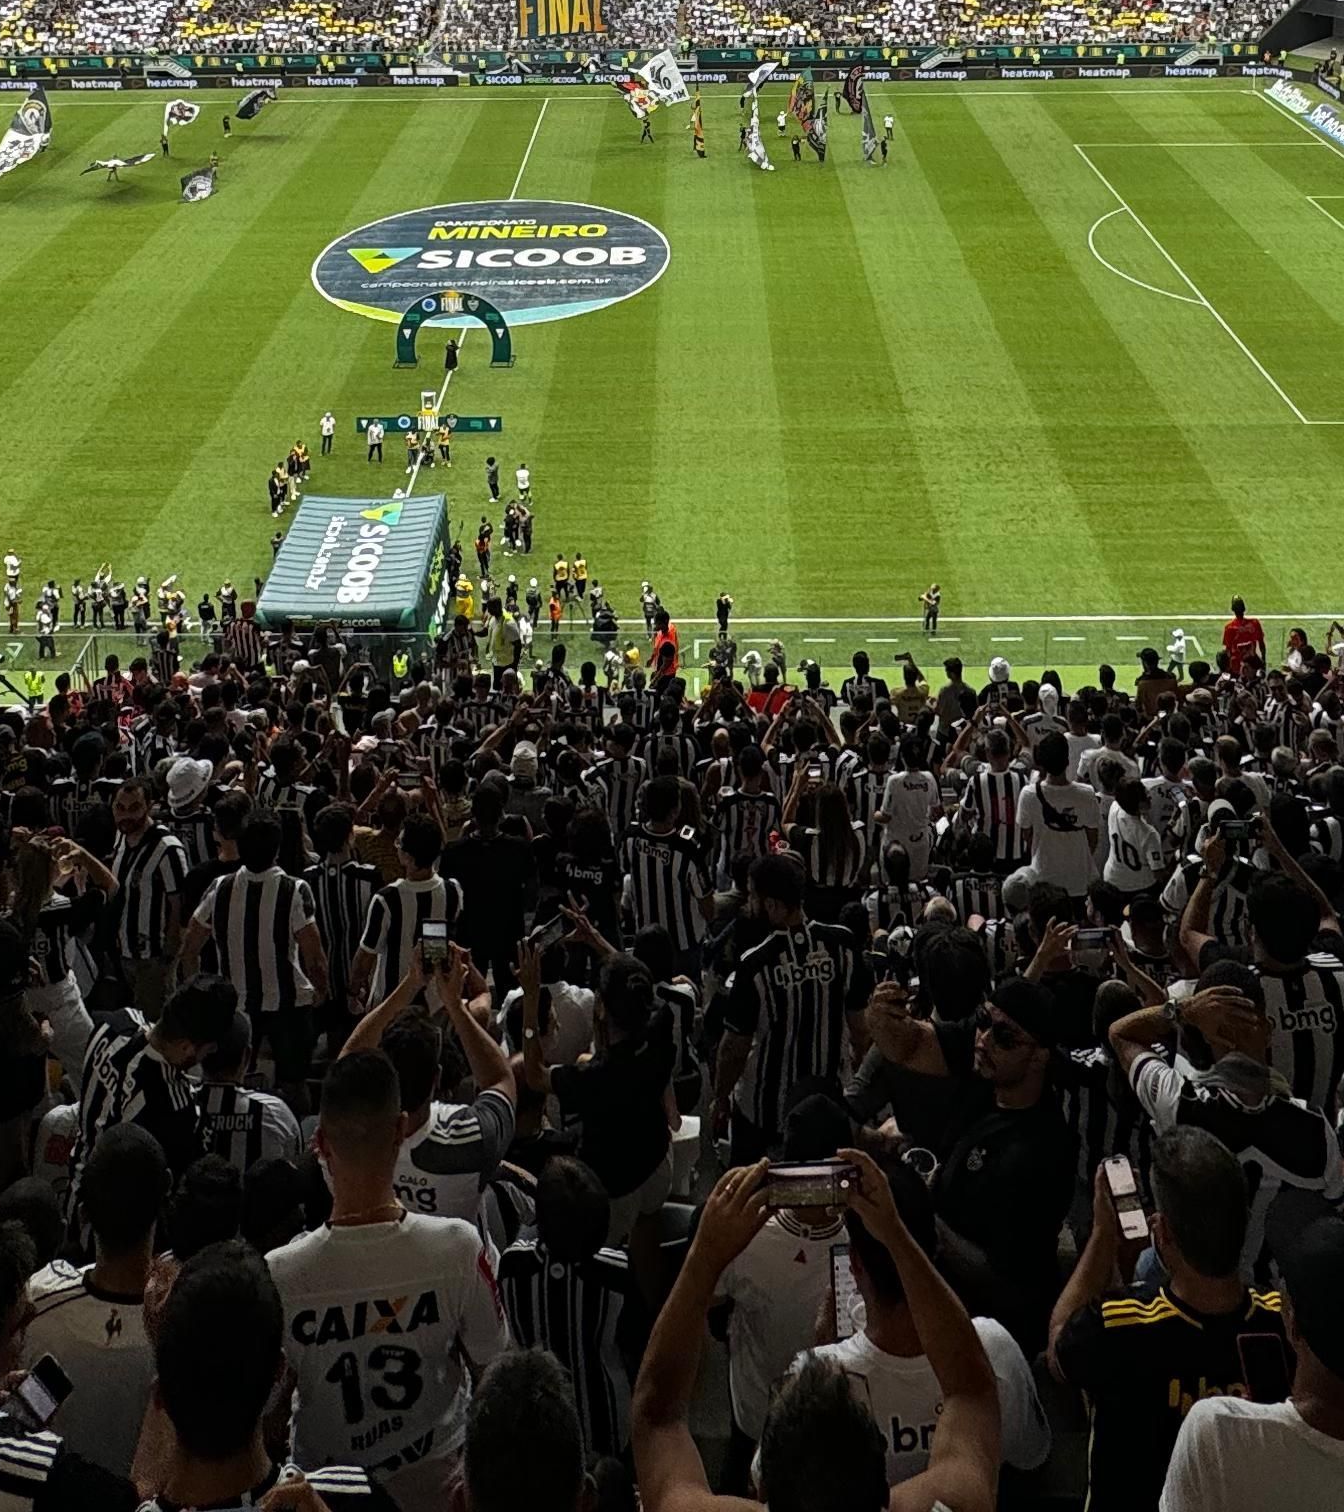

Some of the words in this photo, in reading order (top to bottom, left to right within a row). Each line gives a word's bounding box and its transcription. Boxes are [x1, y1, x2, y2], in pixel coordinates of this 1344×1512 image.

[682, 71, 727, 84] eatmap
[839, 69, 890, 80] hmap
[915, 68, 967, 80] heatmap
[1001, 67, 1053, 80] heatmap
[1079, 66, 1129, 78] heatmap
[1165, 65, 1216, 77] heatmap
[1243, 65, 1292, 79] heatmap
[72, 78, 122, 90] heatmap
[146, 77, 198, 89] heatmap
[231, 75, 282, 87] heatmap
[307, 75, 358, 87] heatmap
[393, 74, 444, 86] heatmap
[486, 74, 522, 85] SICOOB
[435, 219, 536, 227] CAMPEONATO
[428, 224, 608, 240] MINEIRO
[417, 246, 646, 269] SICOOB
[440, 297, 464, 313] FINAL
[337, 523, 391, 604] SICOOB
[342, 619, 381, 627] SICOOB
[644, 840, 671, 866] bmg
[1111, 833, 1142, 871] 10
[573, 862, 603, 886] bmg
[790, 956, 833, 986] bmg
[1280, 1003, 1335, 1035] bmg
[292, 1290, 440, 1345] CAIXA
[326, 1345, 422, 1425] 13
